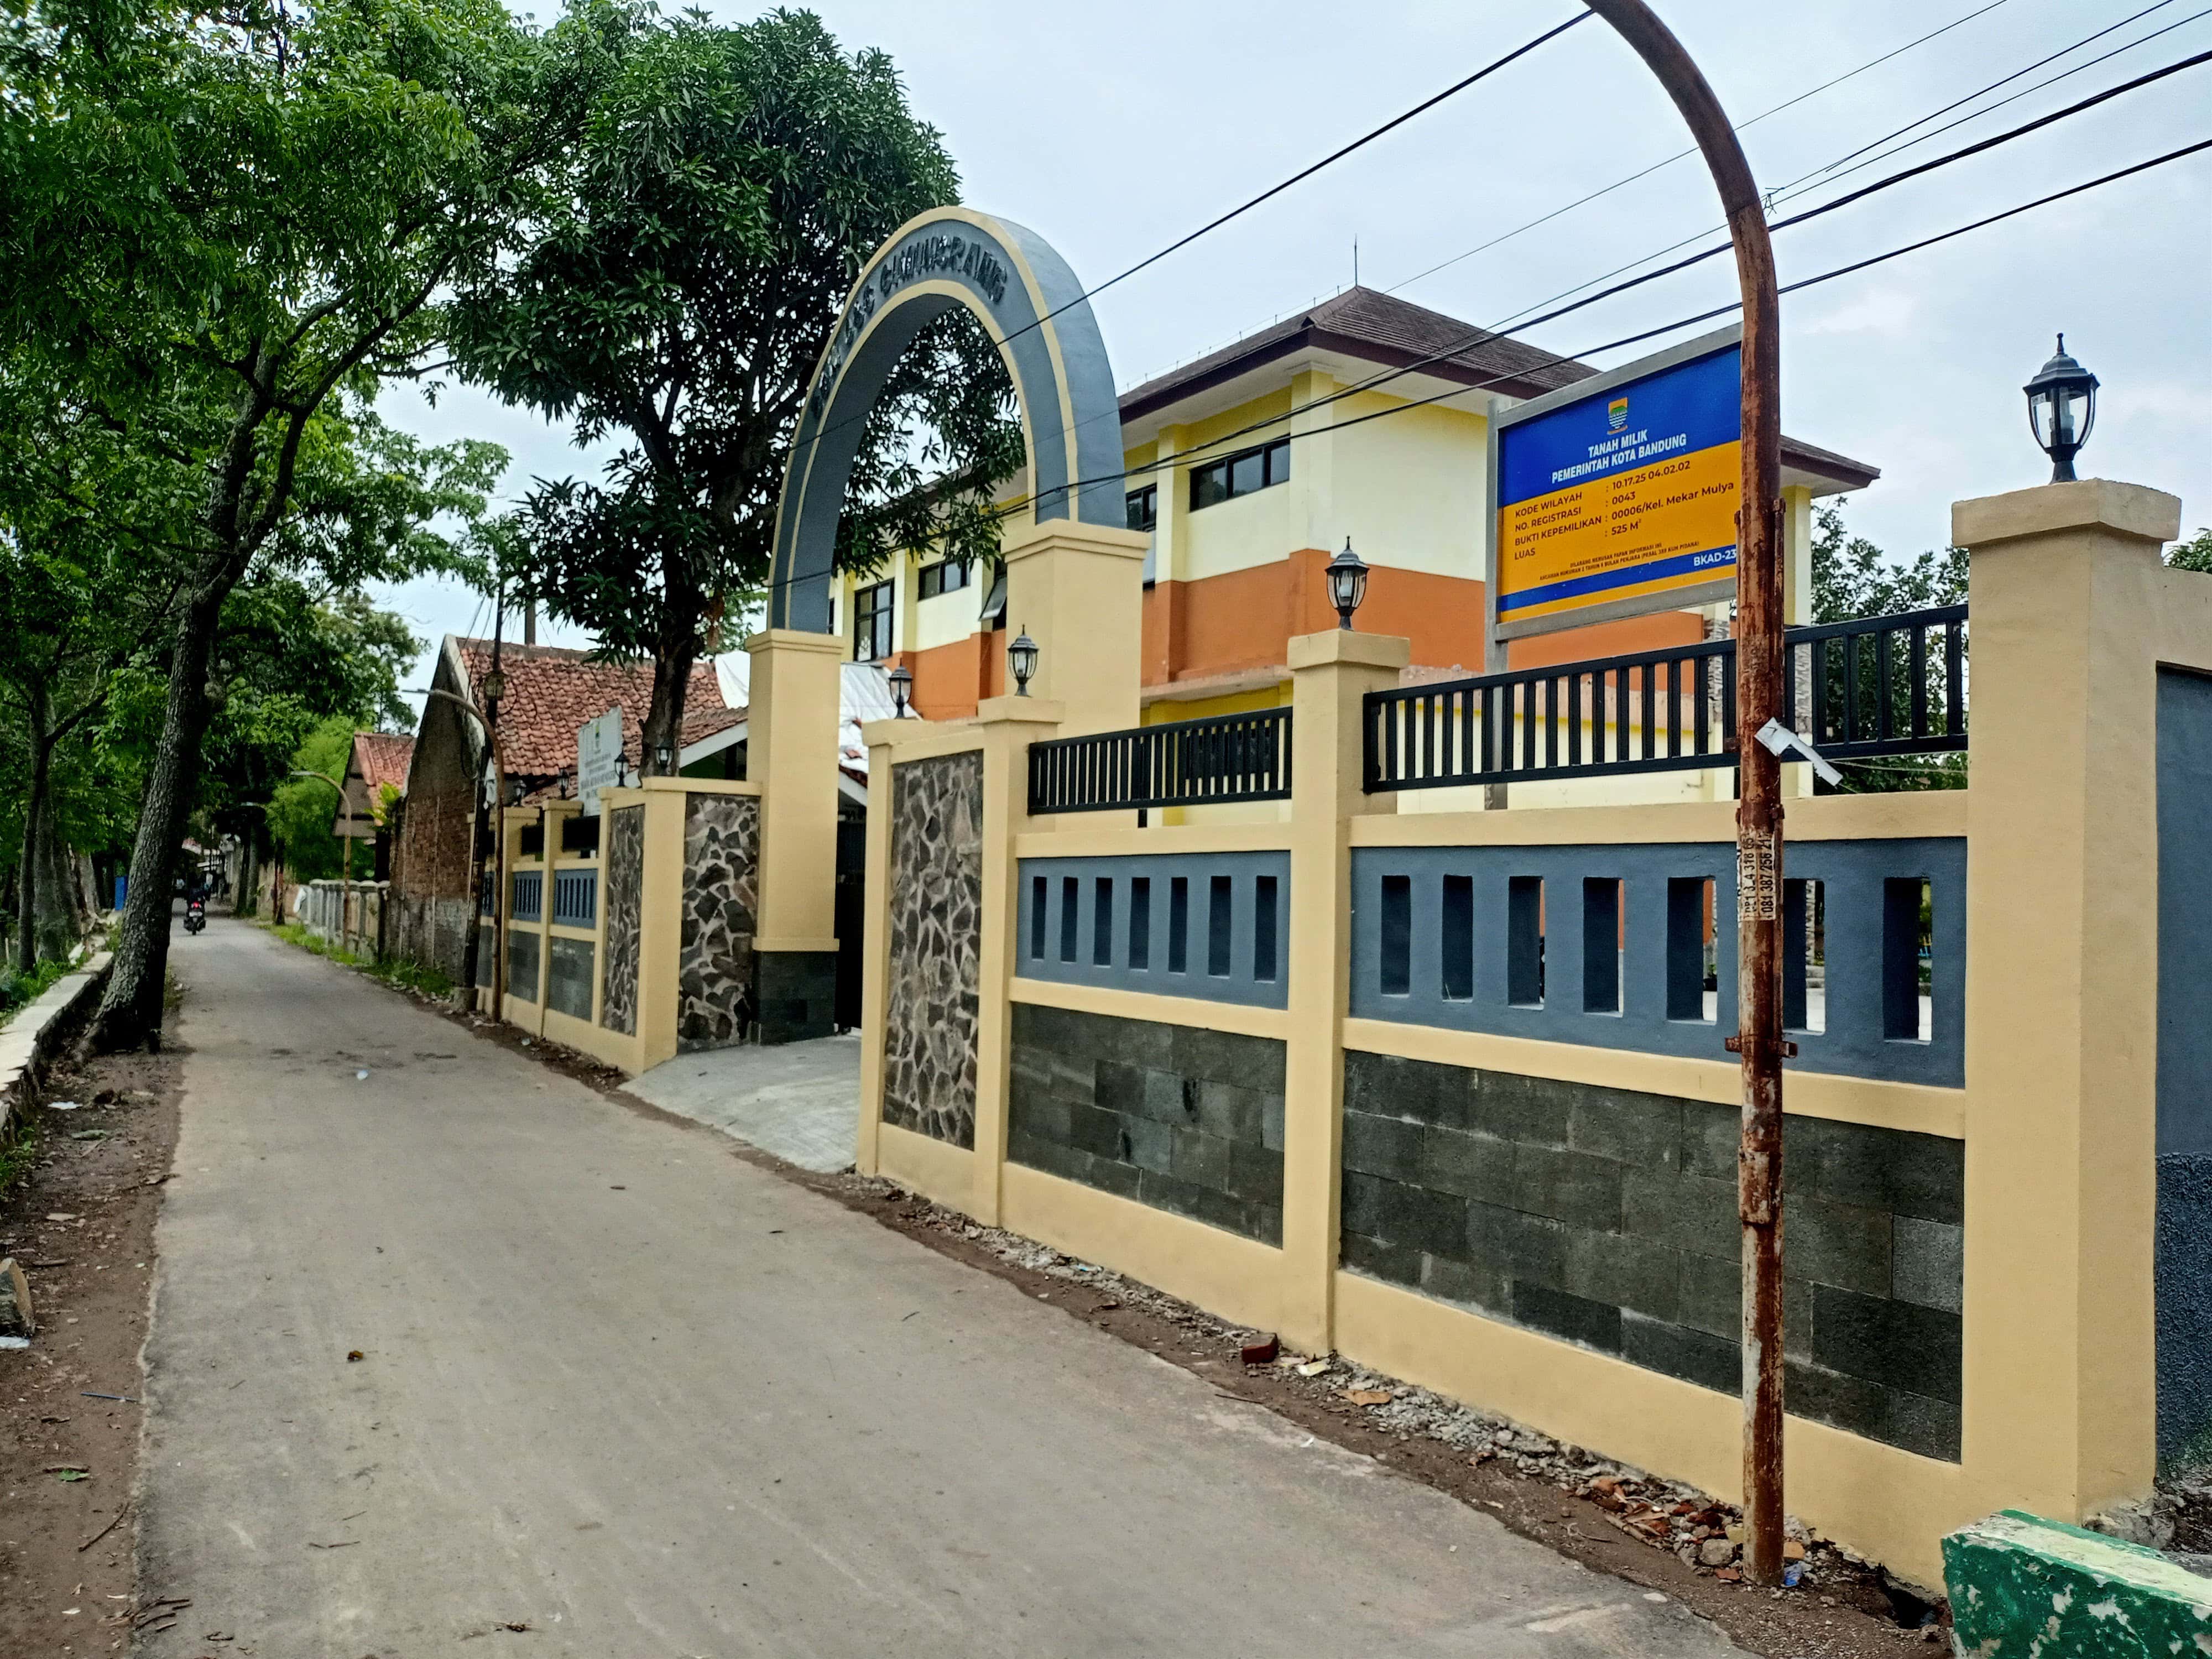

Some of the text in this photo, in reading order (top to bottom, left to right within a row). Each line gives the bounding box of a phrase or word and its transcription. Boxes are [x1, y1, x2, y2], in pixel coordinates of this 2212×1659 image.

[1588, 429, 1647, 458] TANAH MILIK
[1552, 433, 1686, 484] PEMERINTAH KOTA BANDUNG
[1515, 504, 1538, 518] KODE
[1541, 492, 1582, 510] WILAYAH
[1515, 522, 1529, 532] NO.
[1531, 507, 1581, 527] REGISTRASI
[1612, 492, 1635, 504] 0043
[1515, 533, 1538, 546] BUKTI
[1541, 515, 1601, 539] KEPEMILIKAN
[1611, 500, 1663, 520] 00006/Kel.
[1666, 490, 1698, 505] Mekar
[1702, 482, 1734, 497] Mulya
[1514, 547, 1535, 560] LUAS
[1611, 524, 1627, 535] 525
[1570, 559, 1591, 567] DILARANG
[1629, 545, 1653, 554] INFORMASI
[1760, 874, 1773, 891] 387
[1761, 896, 1773, 912] 081
